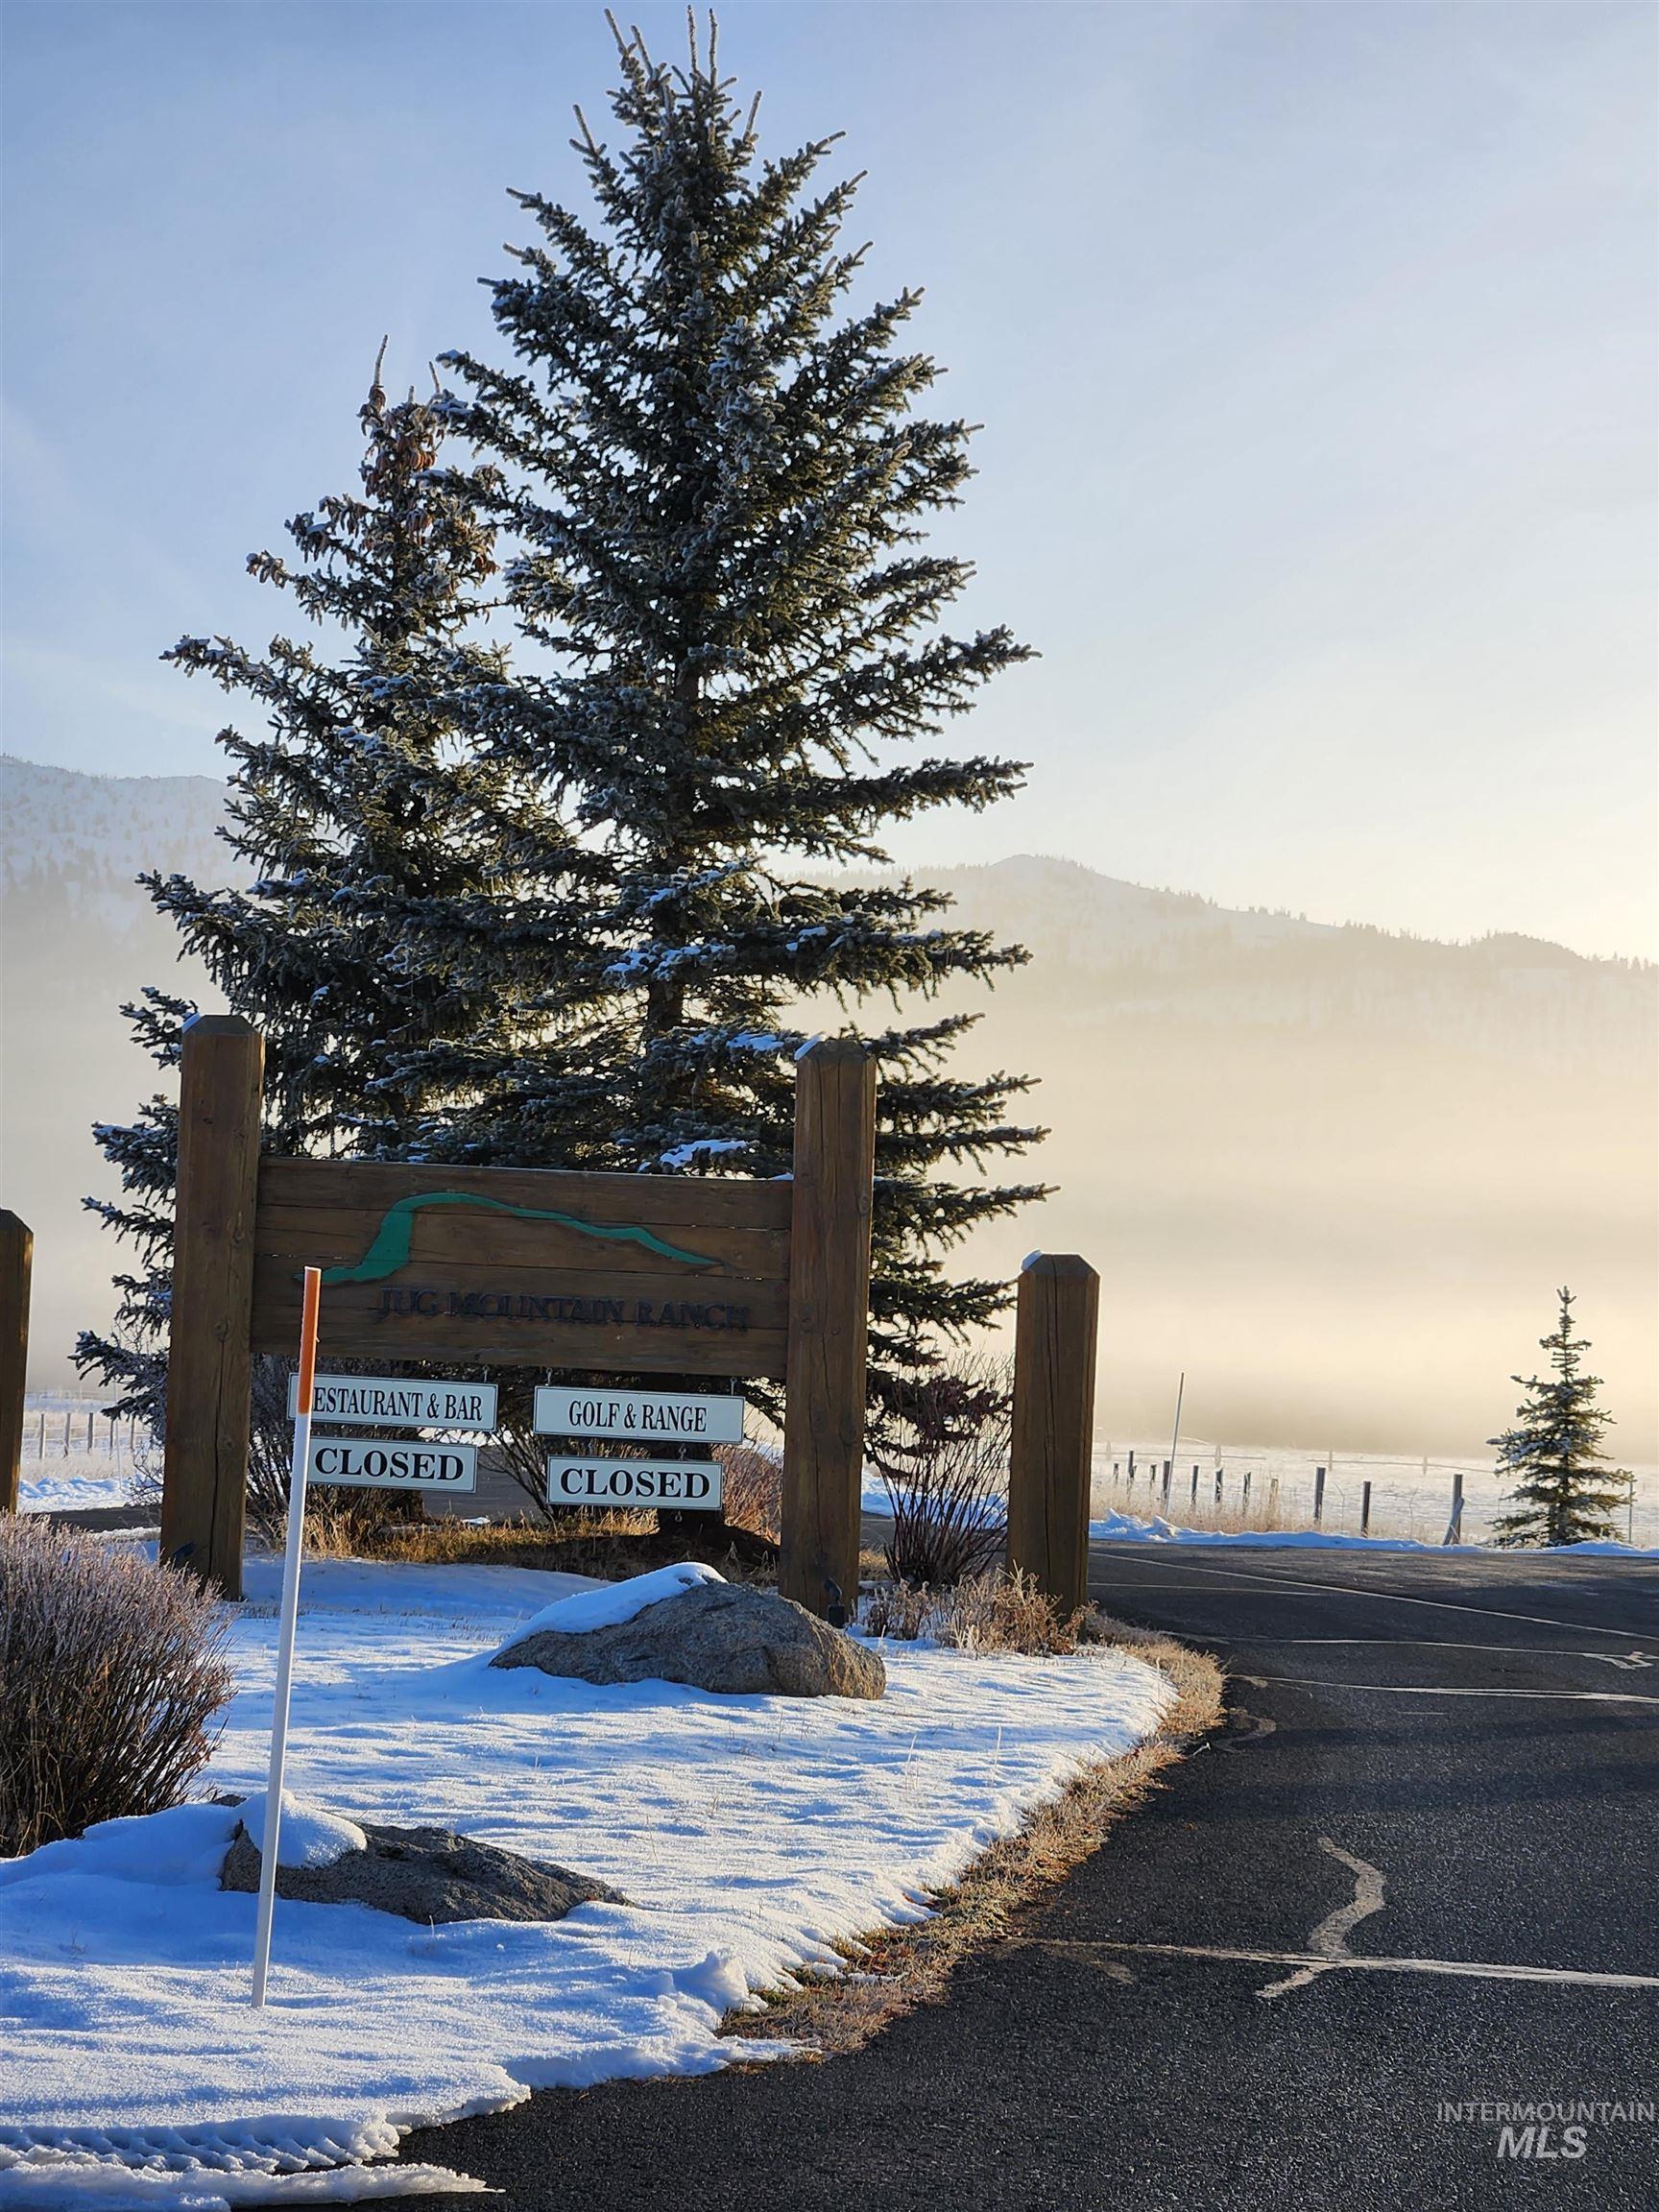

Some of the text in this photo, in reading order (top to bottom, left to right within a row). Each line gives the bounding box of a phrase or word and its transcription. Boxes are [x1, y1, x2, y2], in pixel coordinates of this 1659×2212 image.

[379, 1286, 751, 1333] JUG MOUNTAIN RANCH
[311, 1386, 483, 1422] ESTAURANT & BAR
[568, 1400, 708, 1432] GOLF & RANGE
[314, 1447, 465, 1481] CLOSED
[560, 1467, 710, 1500] CLOSED
